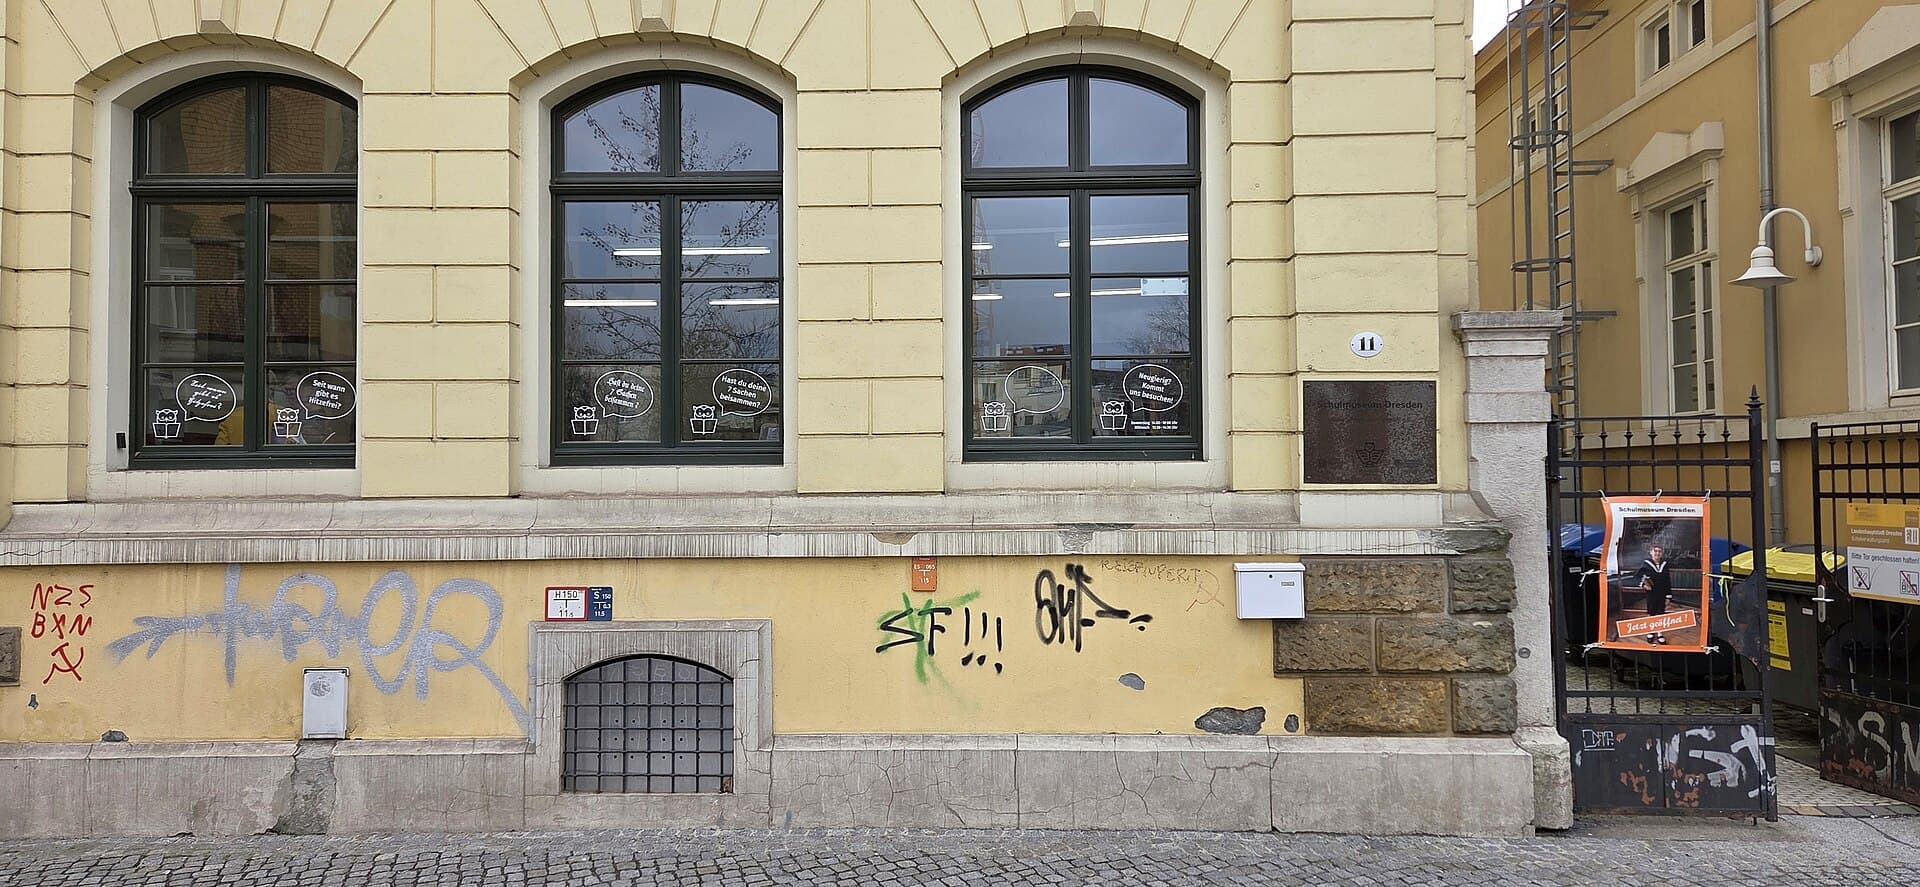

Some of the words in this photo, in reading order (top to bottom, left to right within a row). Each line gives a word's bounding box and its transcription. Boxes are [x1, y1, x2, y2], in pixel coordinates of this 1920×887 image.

[1358, 336, 1377, 351] 11
[312, 379, 328, 389] Seit
[327, 383, 346, 393] wann
[721, 375, 737, 385] Hast
[737, 379, 748, 387] du
[747, 382, 767, 392] deine
[1138, 372, 1173, 386] Neugierig?
[315, 389, 330, 398] gibt
[732, 387, 757, 399] Sachen
[1141, 382, 1165, 393] Kommt
[308, 396, 342, 410] Hitzefrei?
[720, 392, 761, 408] beisammen?
[1129, 389, 1142, 397] uns
[1141, 390, 1174, 404] besuchen!
[1384, 400, 1423, 409] Dresden
[1626, 622, 1647, 633] Jetzt
[1649, 615, 1683, 630] geöffnet
